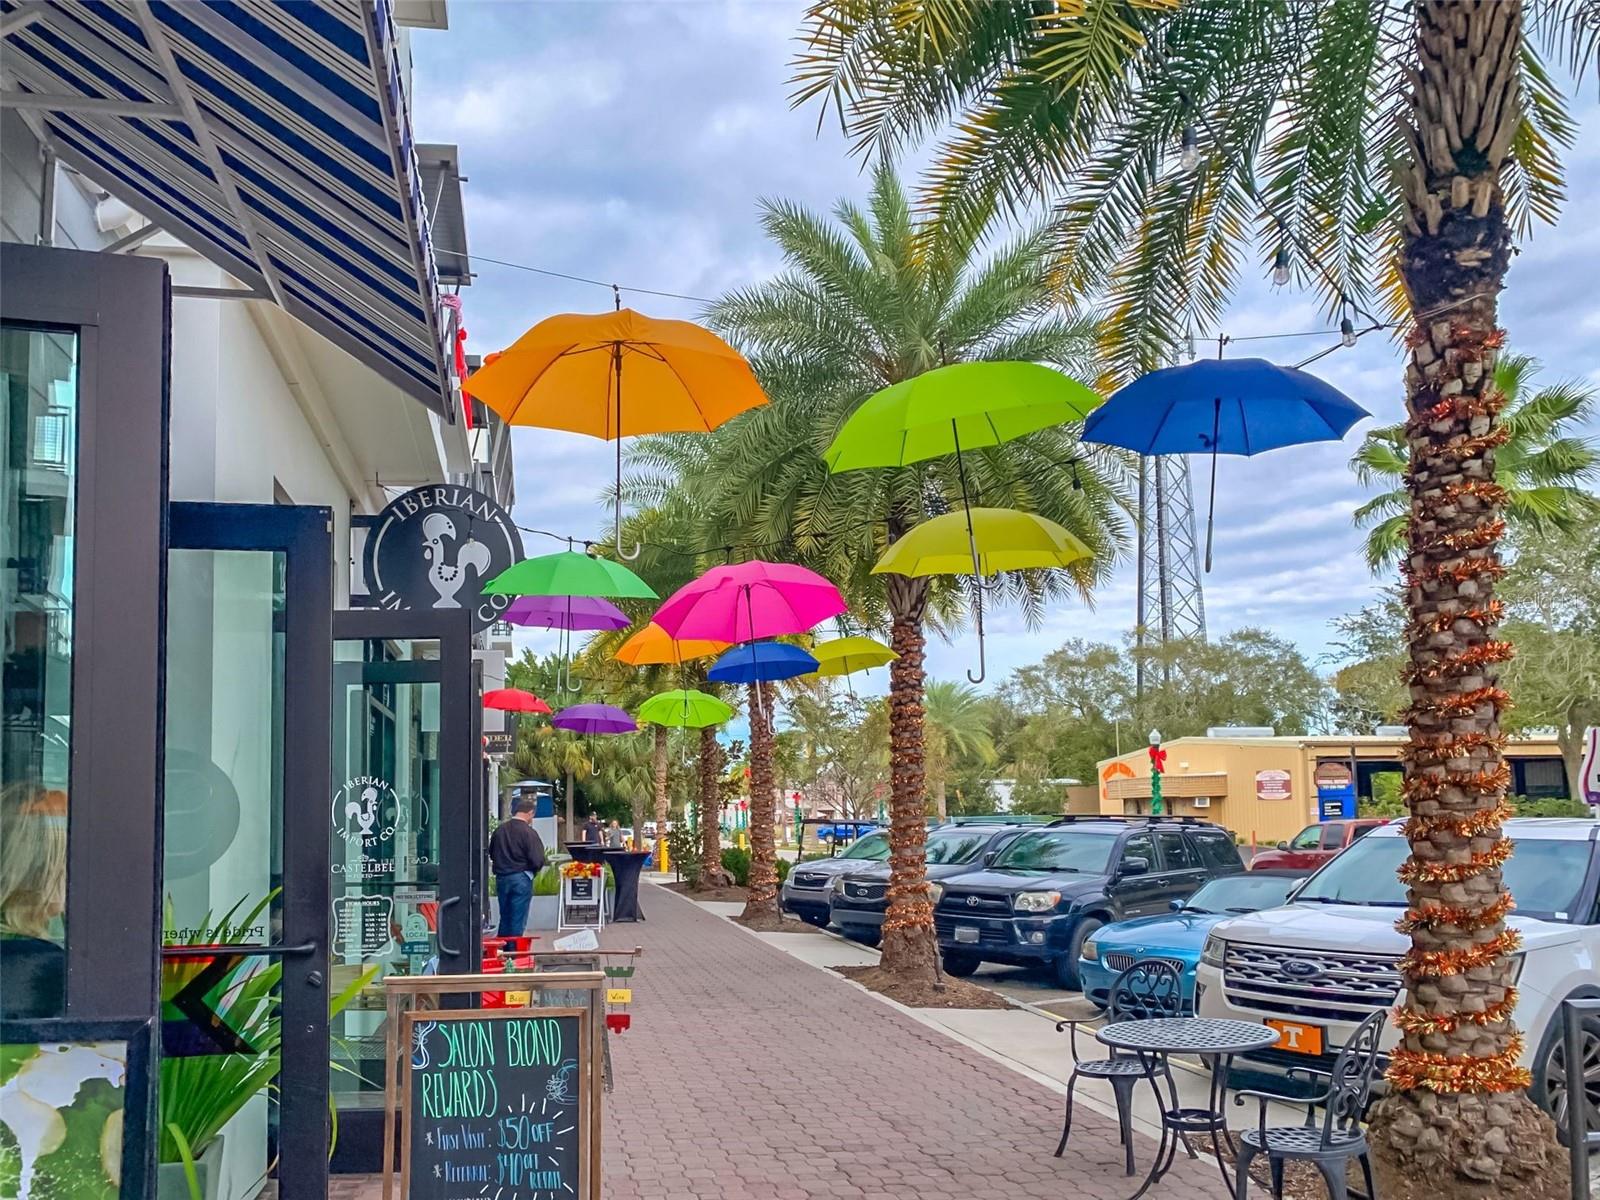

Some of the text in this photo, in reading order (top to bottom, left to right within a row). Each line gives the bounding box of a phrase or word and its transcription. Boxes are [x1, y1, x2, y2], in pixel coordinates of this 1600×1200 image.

[391, 488, 498, 522] IBERIAN
[342, 775, 389, 792] IBERIAN
[336, 827, 379, 848] IMPORT
[438, 1019, 562, 1068] SALON BLOND
[1283, 1025, 1303, 1048] T
[422, 1069, 499, 1119] REWARDS
[496, 1115, 530, 1151] $50
[531, 1121, 555, 1143] OFF
[494, 1152, 523, 1186] $40
[523, 1153, 539, 1170] OFF
